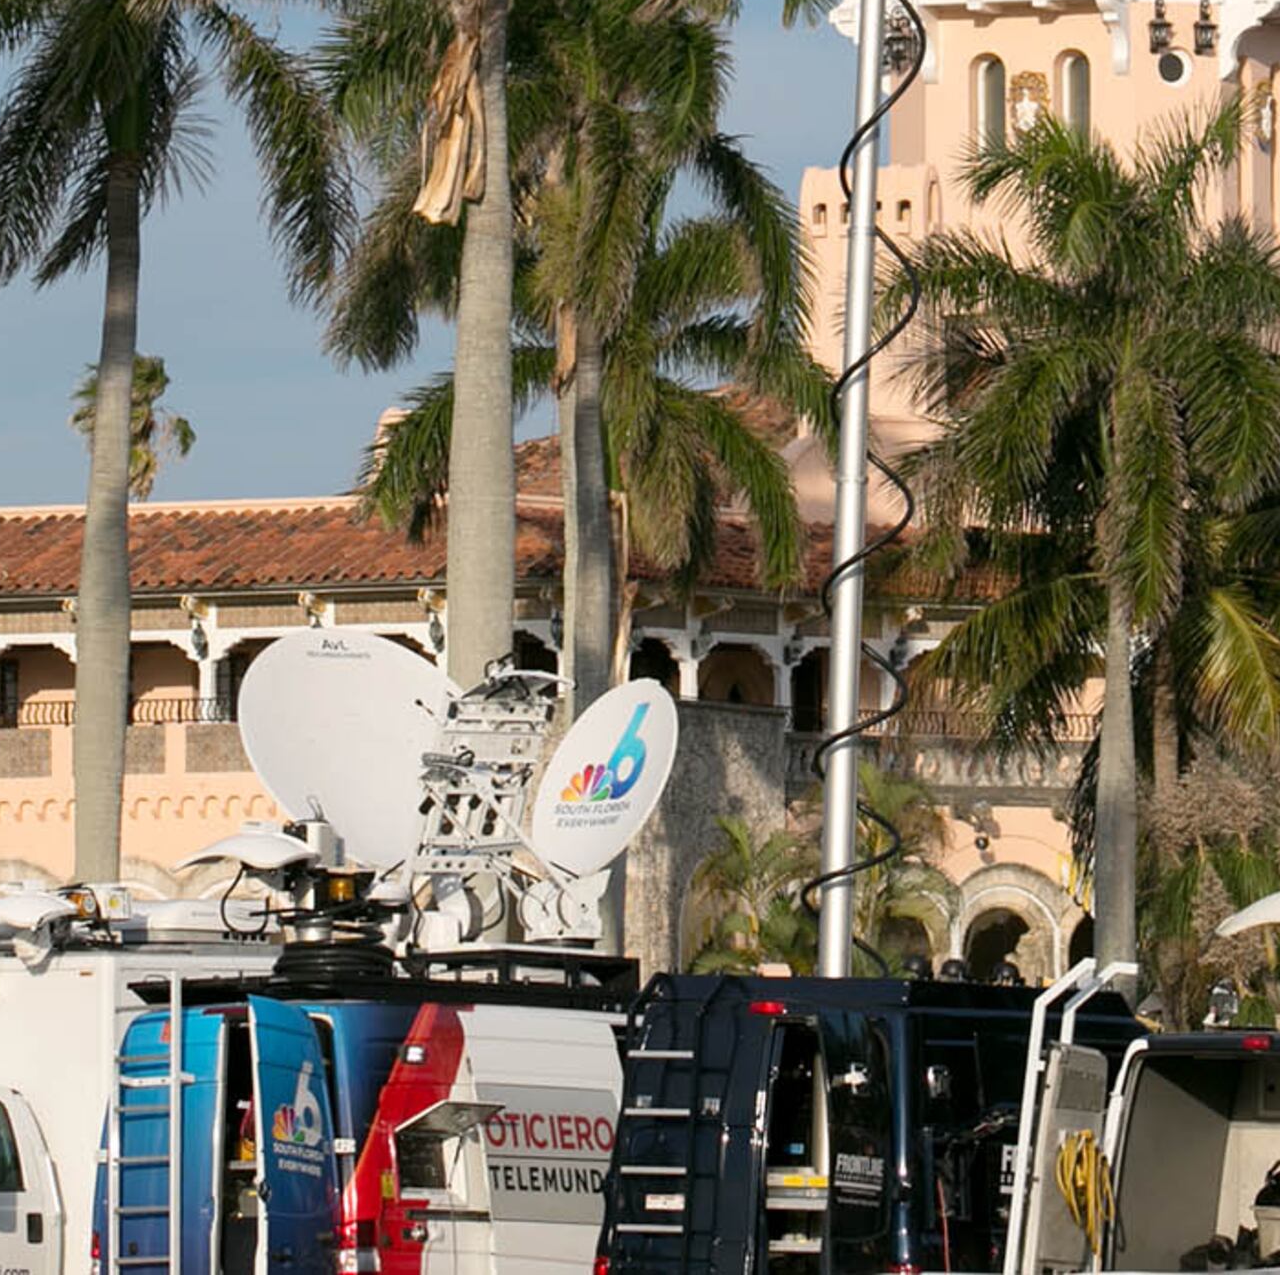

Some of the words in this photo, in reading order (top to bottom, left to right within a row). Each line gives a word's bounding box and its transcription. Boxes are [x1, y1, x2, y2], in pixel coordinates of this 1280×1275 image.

[607, 702, 651, 799] 6
[555, 803, 591, 815] SOUTH
[484, 1112, 616, 1153] OTICIERO
[488, 1164, 606, 1194] TELEMUND
